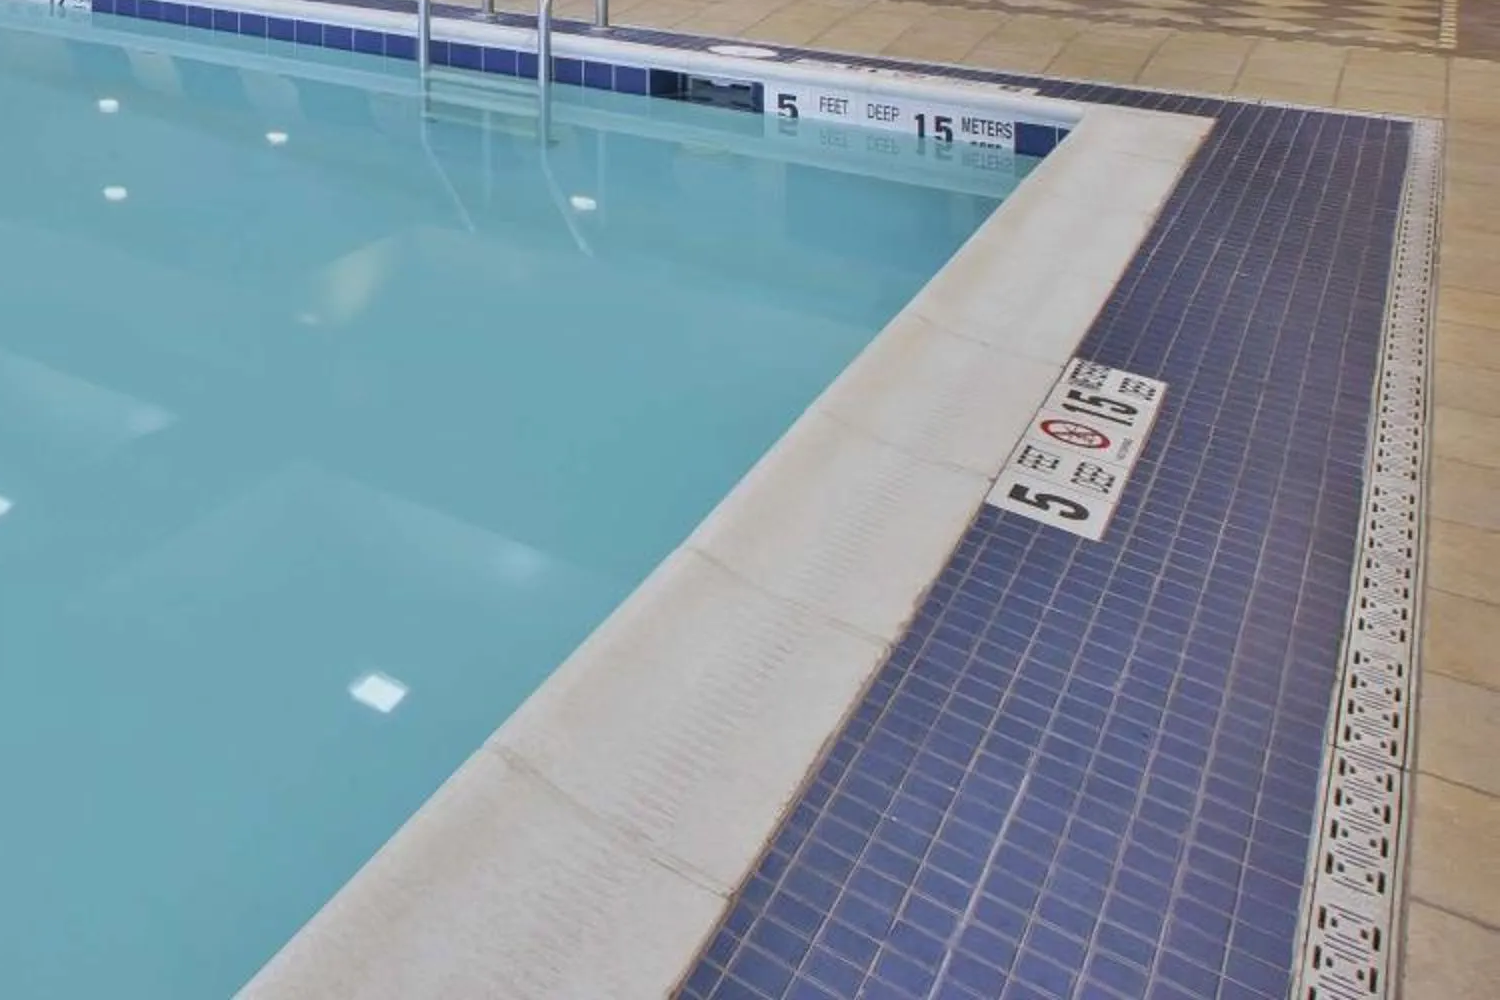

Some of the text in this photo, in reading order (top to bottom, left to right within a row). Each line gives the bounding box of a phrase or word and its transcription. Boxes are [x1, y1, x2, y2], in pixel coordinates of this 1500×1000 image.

[777, 93, 799, 119] 5
[819, 96, 849, 115] FEET
[867, 103, 901, 122] DEEP
[961, 116, 1013, 139] METERS
[1008, 483, 1090, 521] 5
